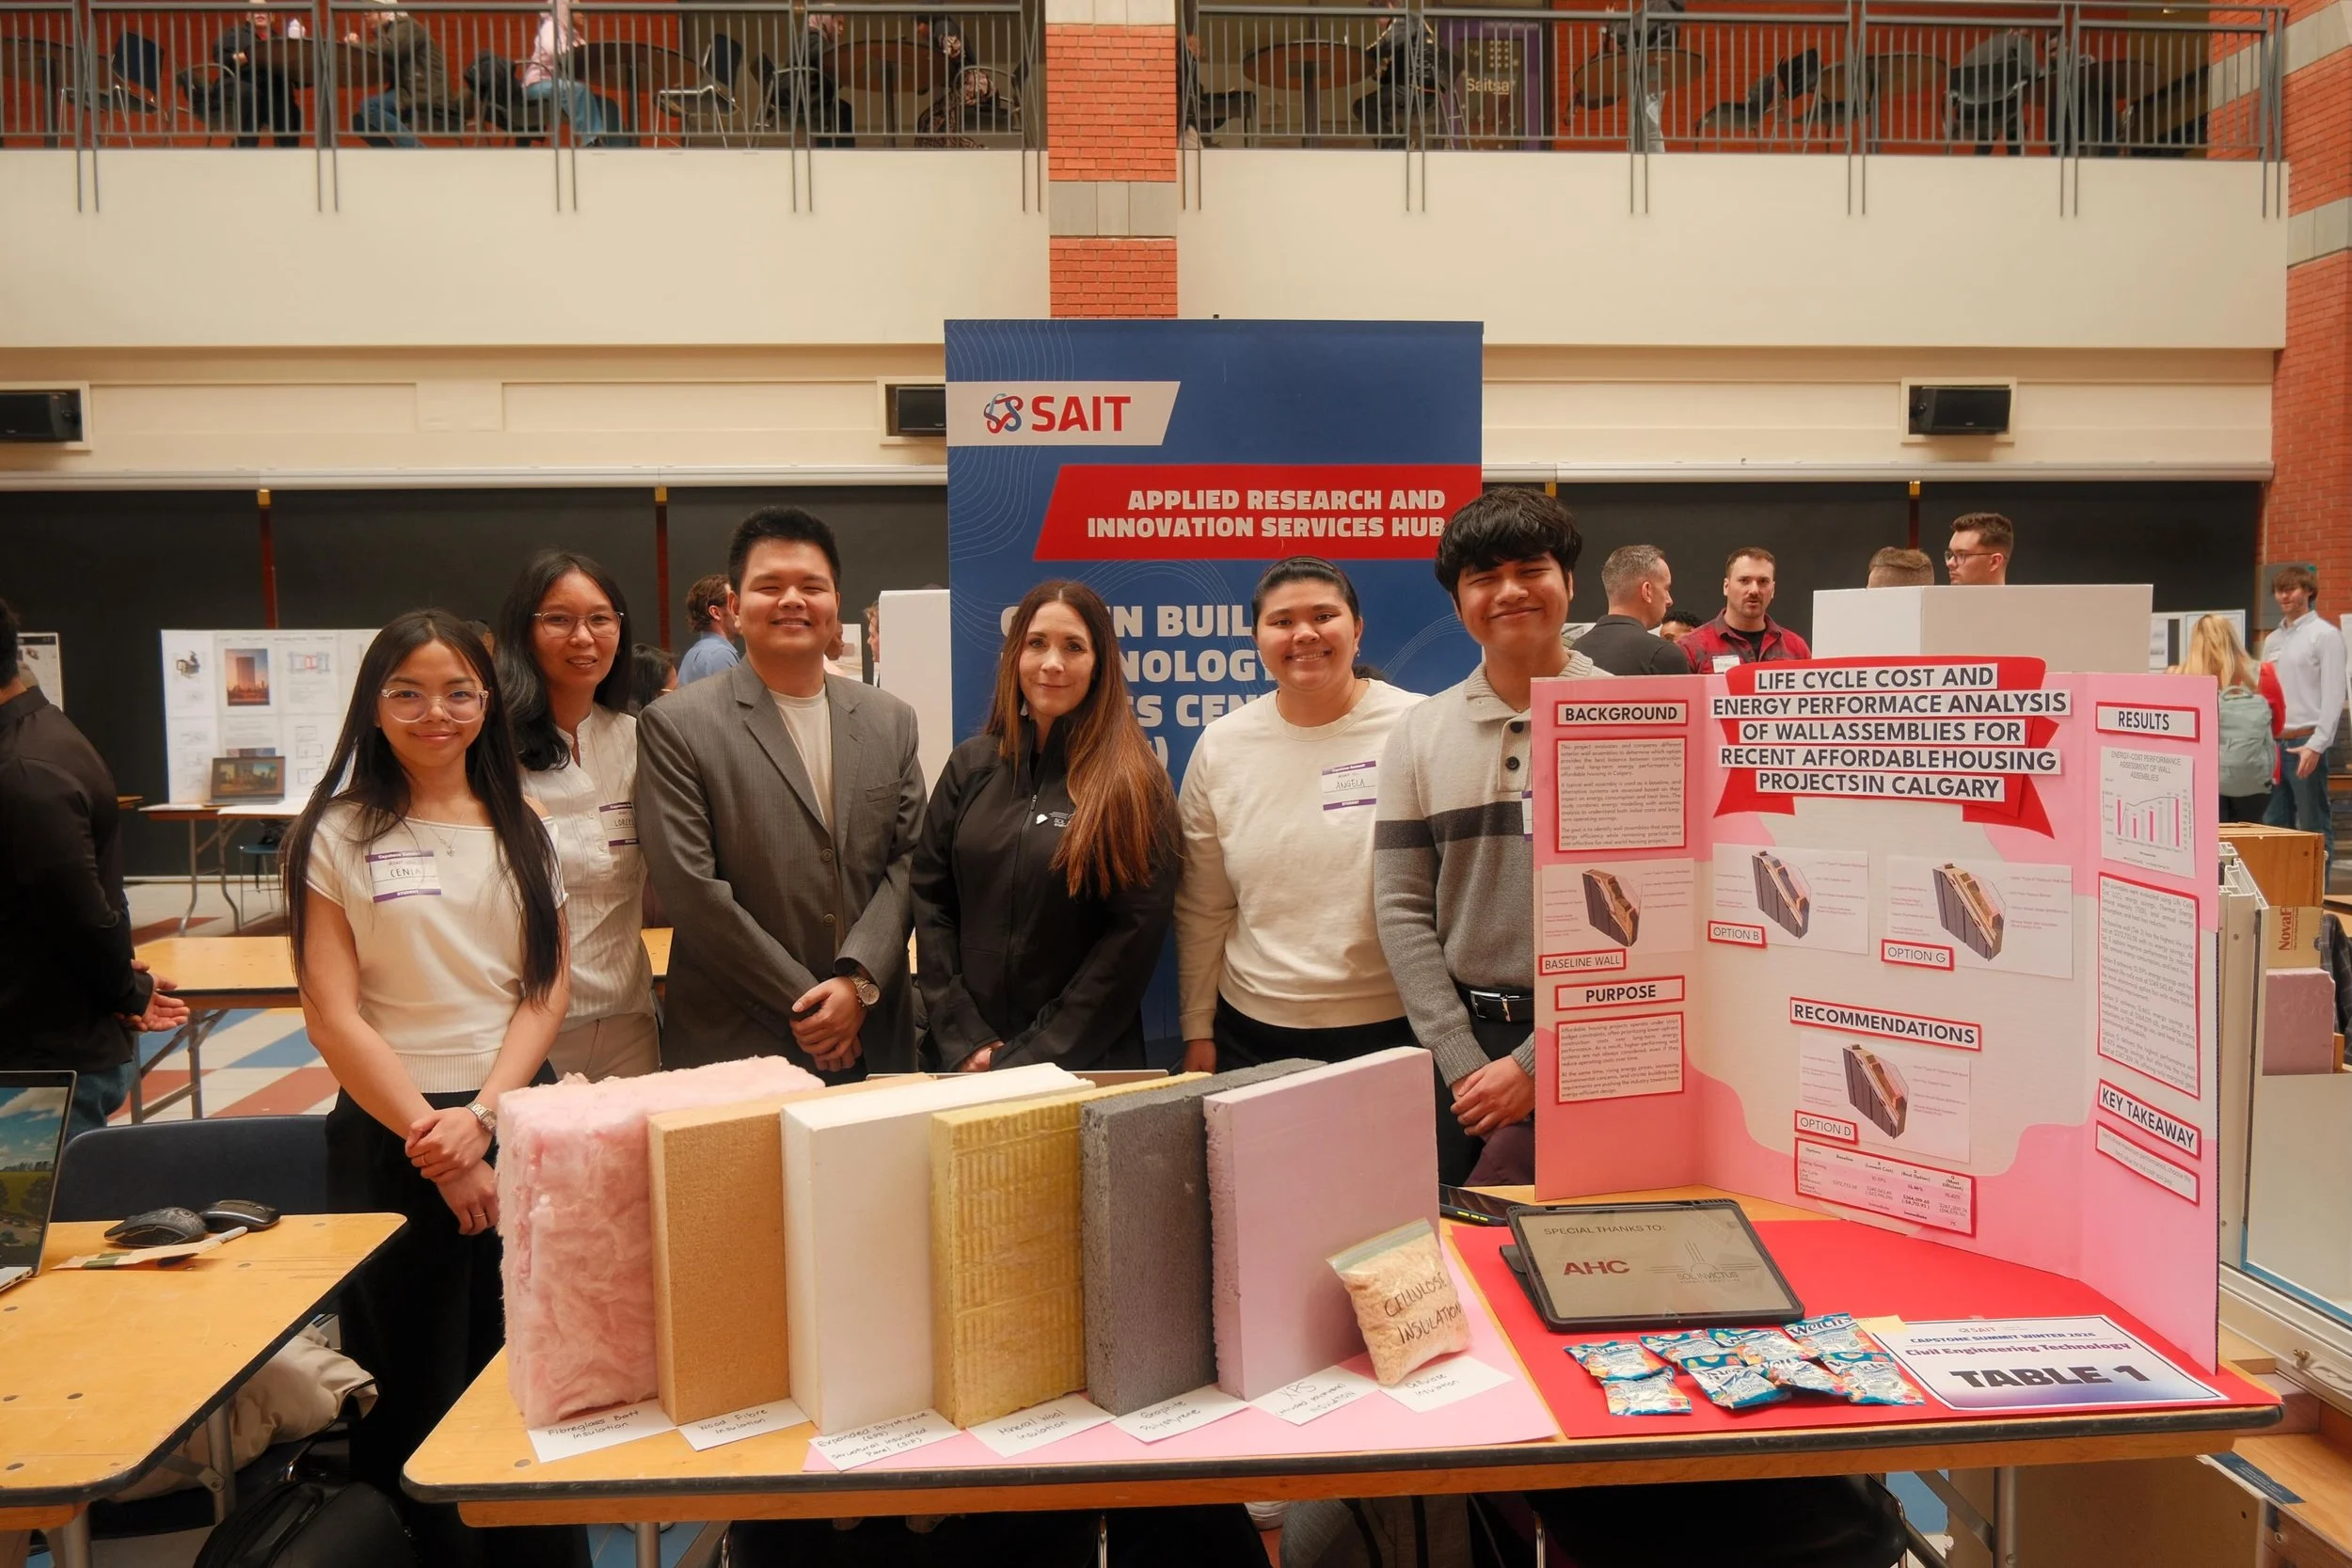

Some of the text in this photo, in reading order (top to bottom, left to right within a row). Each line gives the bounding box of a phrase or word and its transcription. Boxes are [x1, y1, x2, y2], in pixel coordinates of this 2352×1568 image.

[1031, 395, 1131, 432] SAIT
[1128, 490, 1446, 510] APPLIED RESEARCH AND
[1088, 516, 1446, 538] INNOVATION SERVICES HUB
[1157, 605, 1253, 638] BUIL
[1757, 672, 1796, 690] LIFE
[1803, 671, 1867, 689] CYCLE
[1875, 669, 1935, 688] COST
[1942, 667, 1994, 687] AND
[1565, 706, 1677, 721] BACKGROUND
[1713, 692, 2067, 716] ENERGY PERFORMACE ANALYSIS
[2118, 710, 2169, 731] RESULTS
[1742, 723, 1769, 740] OF
[1975, 722, 2021, 741] FOR
[1721, 748, 1795, 766] RECENT
[1336, 779, 1365, 790] ANGELA
[1891, 776, 2000, 799] CALGARY
[1713, 927, 1760, 941] OPTION B
[1545, 955, 1621, 970] BASELINE WALL
[1888, 946, 1946, 963] OPTION G
[1585, 985, 1657, 1003] PURPOSE
[1794, 1004, 1976, 1044] RECOMMENDATIONS
[1800, 1117, 1851, 1136] OPTION D
[2103, 1087, 2122, 1112] KEY
[2126, 1101, 2195, 1148] TAKEAWAY
[1544, 1224, 1666, 1236] SPECIAL THANKS TO:
[1563, 1259, 1630, 1276] AHC
[1677, 1271, 1739, 1280] SOL INVICTUS
[1384, 1271, 1447, 1318] CELLULOSE
[1397, 1302, 1462, 1344] INSULATION
[1910, 1331, 2096, 1344] CAPSTONE SUMMIT WINTER 2026
[1905, 1341, 2132, 1357] Civil Engineering Technology
[1405, 1372, 1447, 1390] Cellulose
[1949, 1365, 2151, 1388] TABLE 1
[1277, 1381, 1317, 1402] XPS
[1139, 1408, 1201, 1432] Polystyrene
[1140, 1401, 1187, 1418] Graphite
[548, 1410, 640, 1436] Fibreglass Batt
[698, 1408, 769, 1433] Wood Fibre
[997, 1409, 1066, 1436] Mineral Wool
[817, 1428, 870, 1449] Expanded
